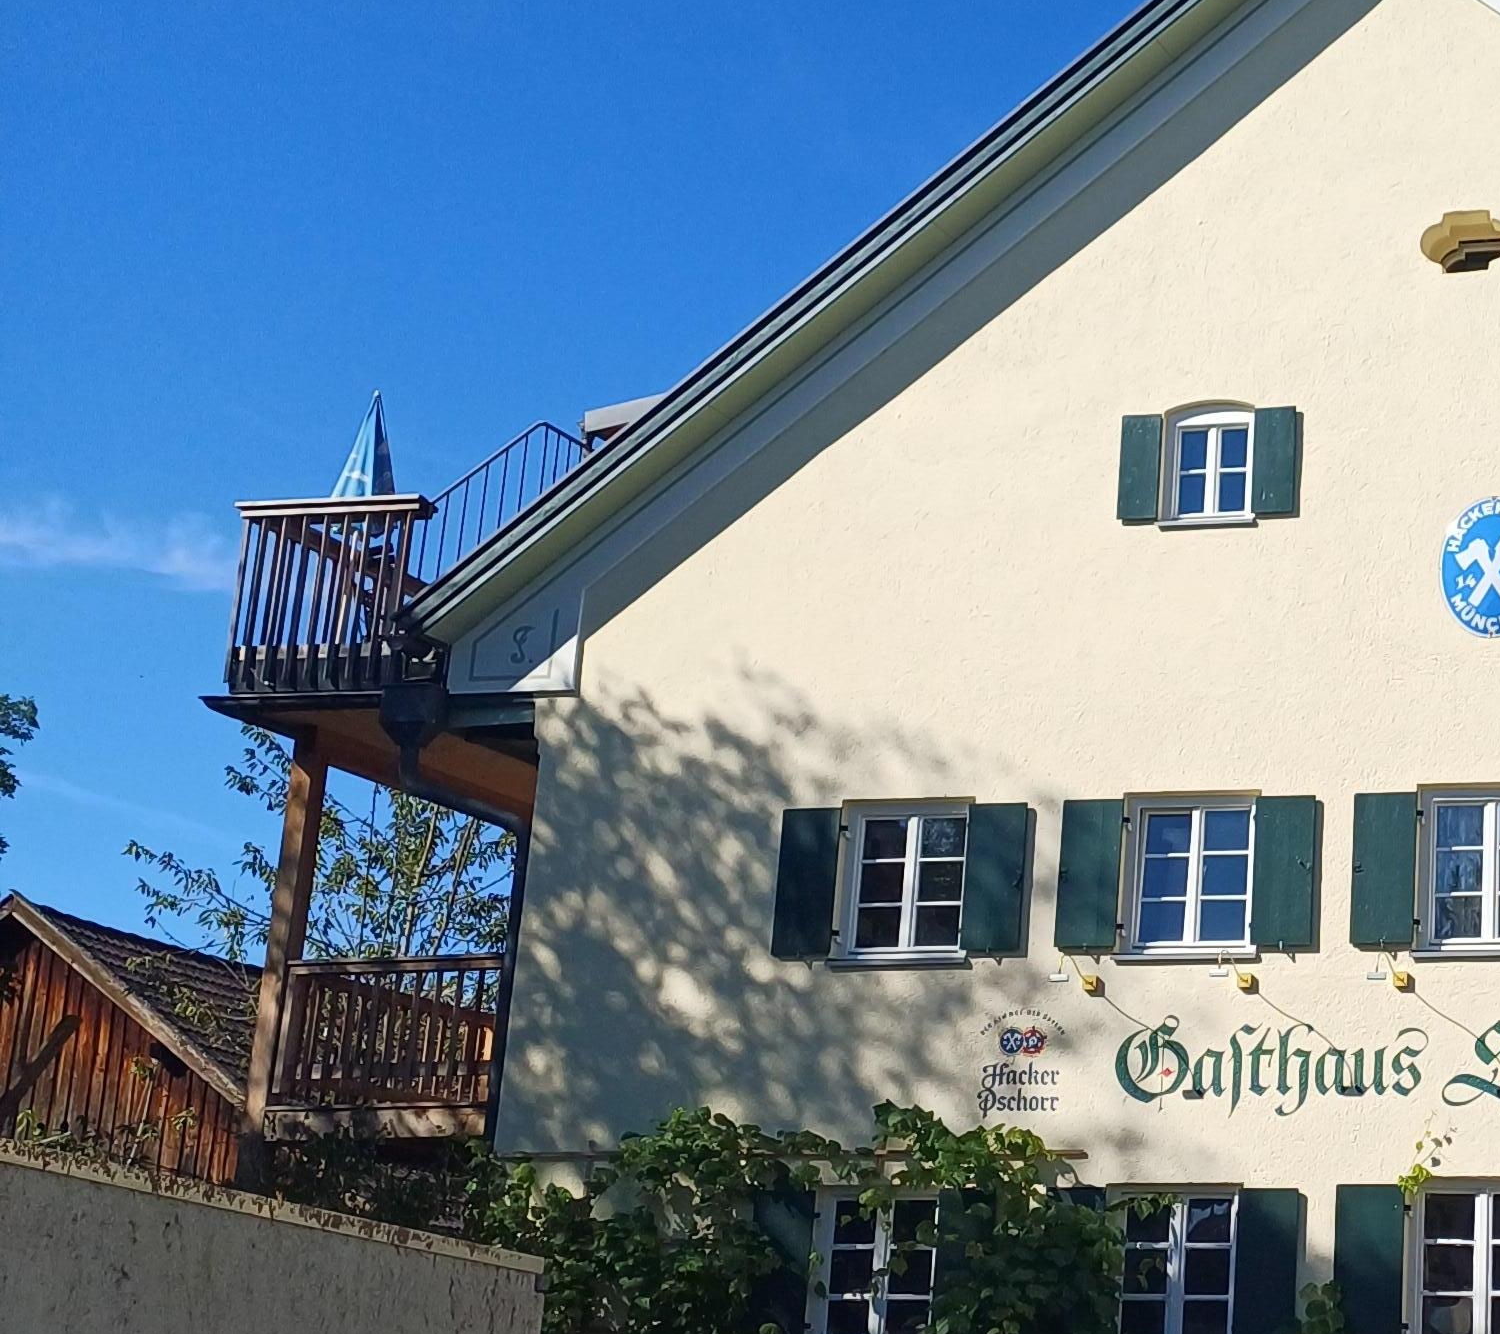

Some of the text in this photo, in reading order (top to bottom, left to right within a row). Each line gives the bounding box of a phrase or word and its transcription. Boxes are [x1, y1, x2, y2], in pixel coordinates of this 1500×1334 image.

[1455, 574, 1477, 589] 14
[981, 1061, 1060, 1089] Hacker
[977, 1088, 1060, 1119] Pschorr
